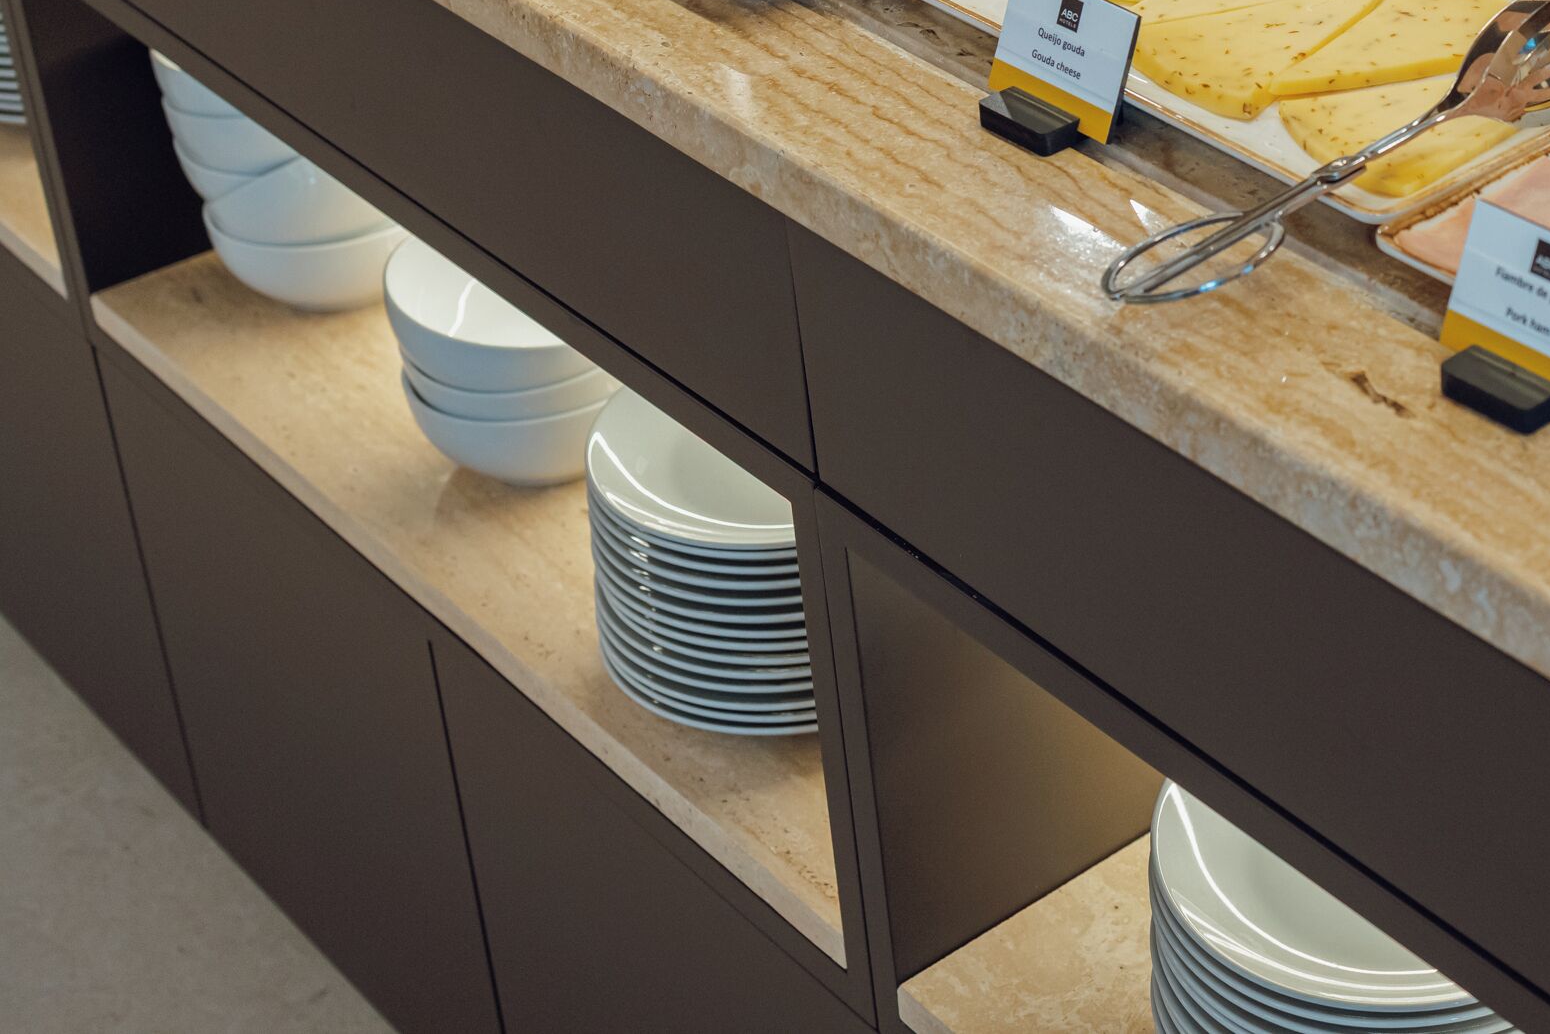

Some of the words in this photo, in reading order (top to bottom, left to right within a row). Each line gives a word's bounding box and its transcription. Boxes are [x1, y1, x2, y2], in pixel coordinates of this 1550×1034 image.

[1059, 18, 1077, 29] HOTELS
[1060, 8, 1079, 22] ABC
[1038, 27, 1061, 46] Queijo
[1062, 40, 1085, 57] gouda
[1031, 49, 1055, 67] Gouda
[1056, 61, 1081, 80] cheese
[1495, 266, 1534, 293] Fiambre
[1536, 287, 1548, 299] de
[1505, 307, 1528, 325] Pork
